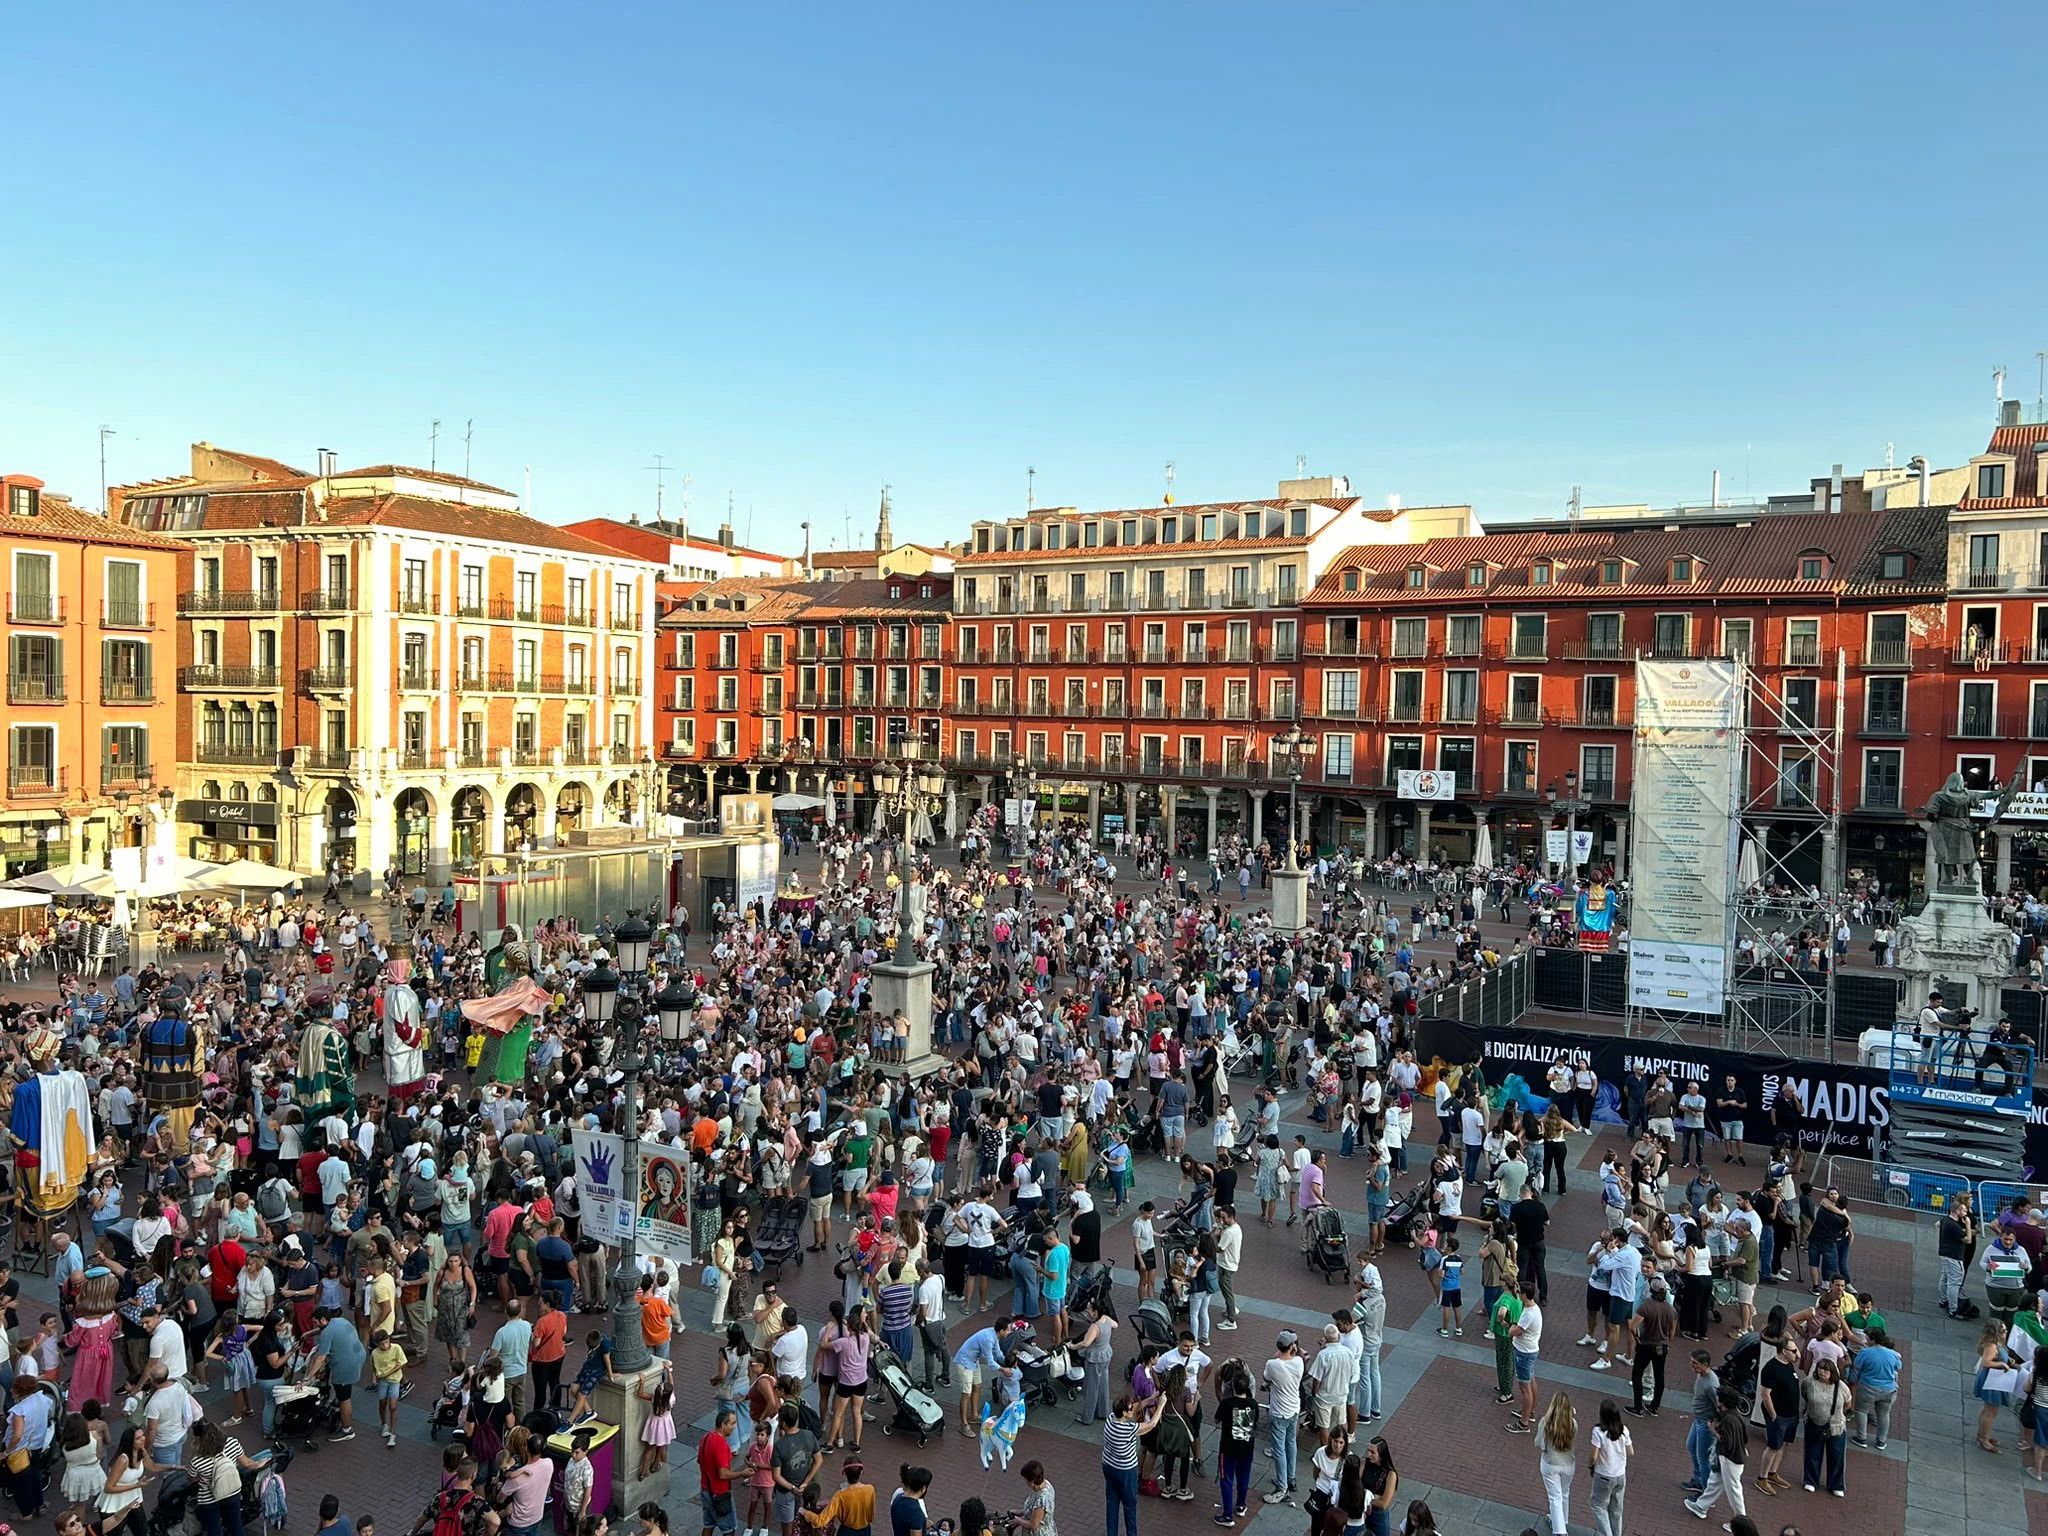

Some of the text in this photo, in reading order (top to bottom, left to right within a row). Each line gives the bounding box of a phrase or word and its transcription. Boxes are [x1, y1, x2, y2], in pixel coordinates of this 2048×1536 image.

[1637, 698, 1659, 709] 25
[1635, 987, 1651, 995] gaza
[1493, 1042, 1591, 1067] DIGITALIZACIÓN
[1634, 1056, 1710, 1082] MARKETING
[1762, 1074, 1780, 1111] SOMOS
[1786, 1076, 1890, 1127] MADIS
[1934, 1091, 1992, 1105] maxber
[636, 1218, 651, 1228] 25
